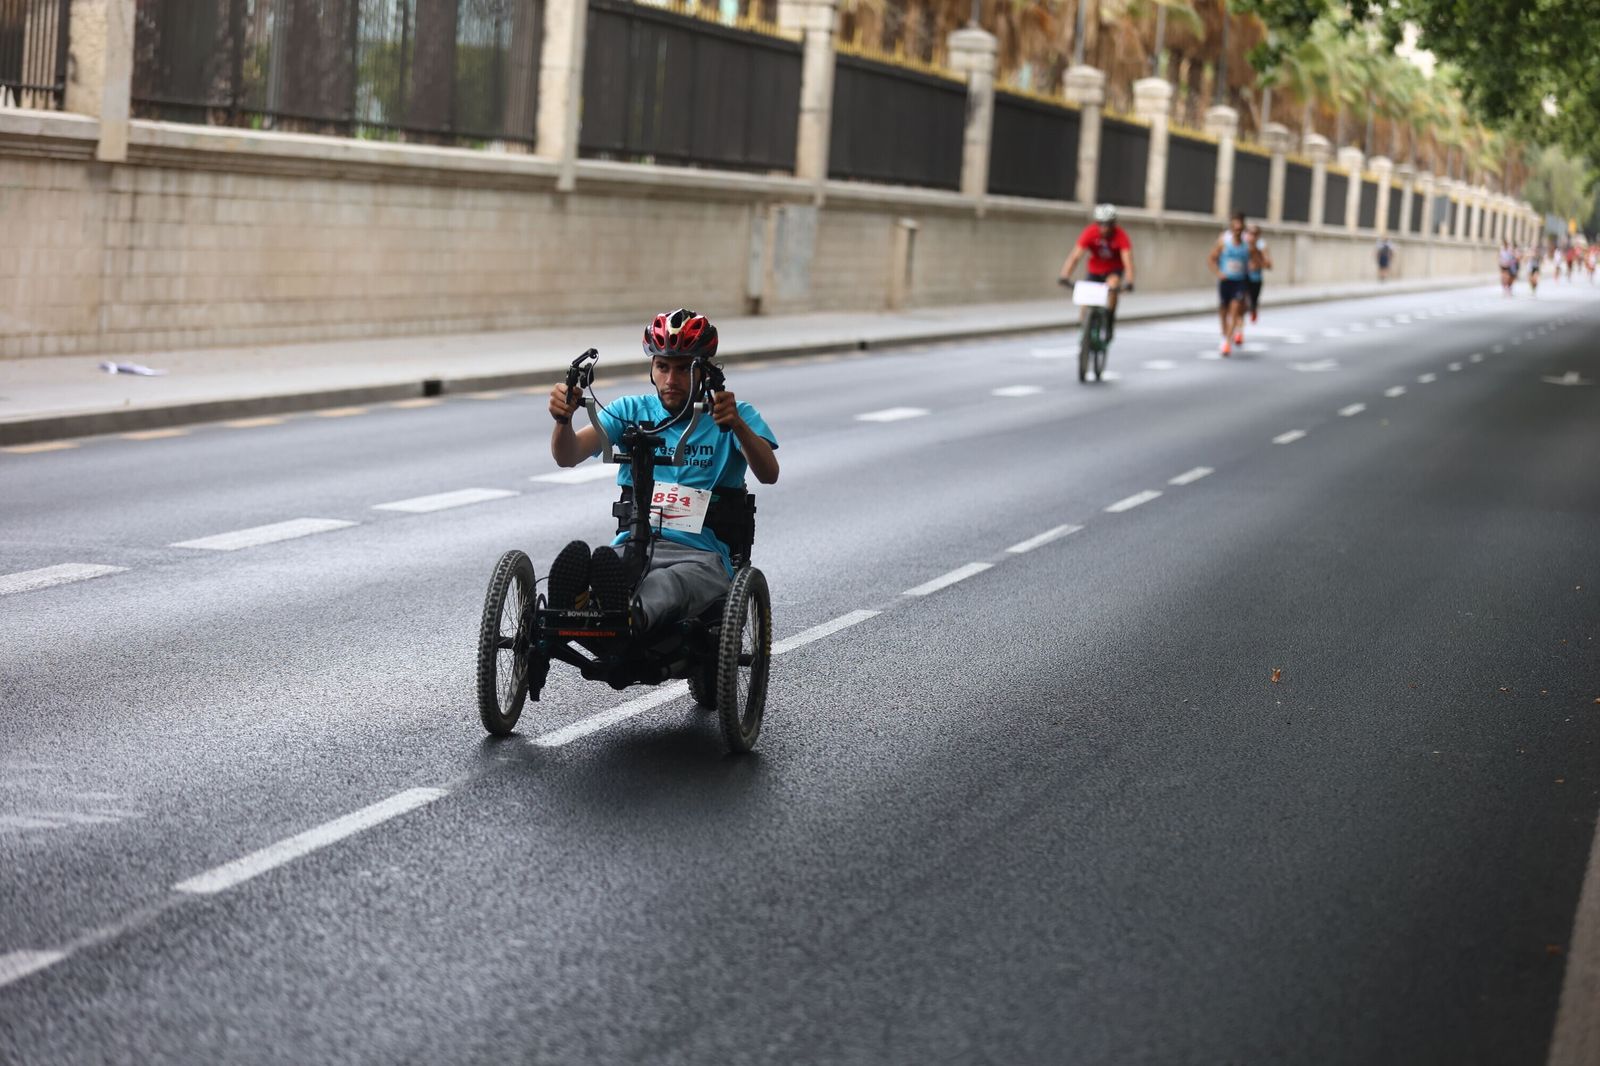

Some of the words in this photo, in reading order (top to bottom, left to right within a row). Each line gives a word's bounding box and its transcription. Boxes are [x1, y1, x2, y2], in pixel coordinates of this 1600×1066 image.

[660, 444, 714, 457] asaym
[680, 457, 713, 468] álaga
[653, 492, 691, 507] 854
